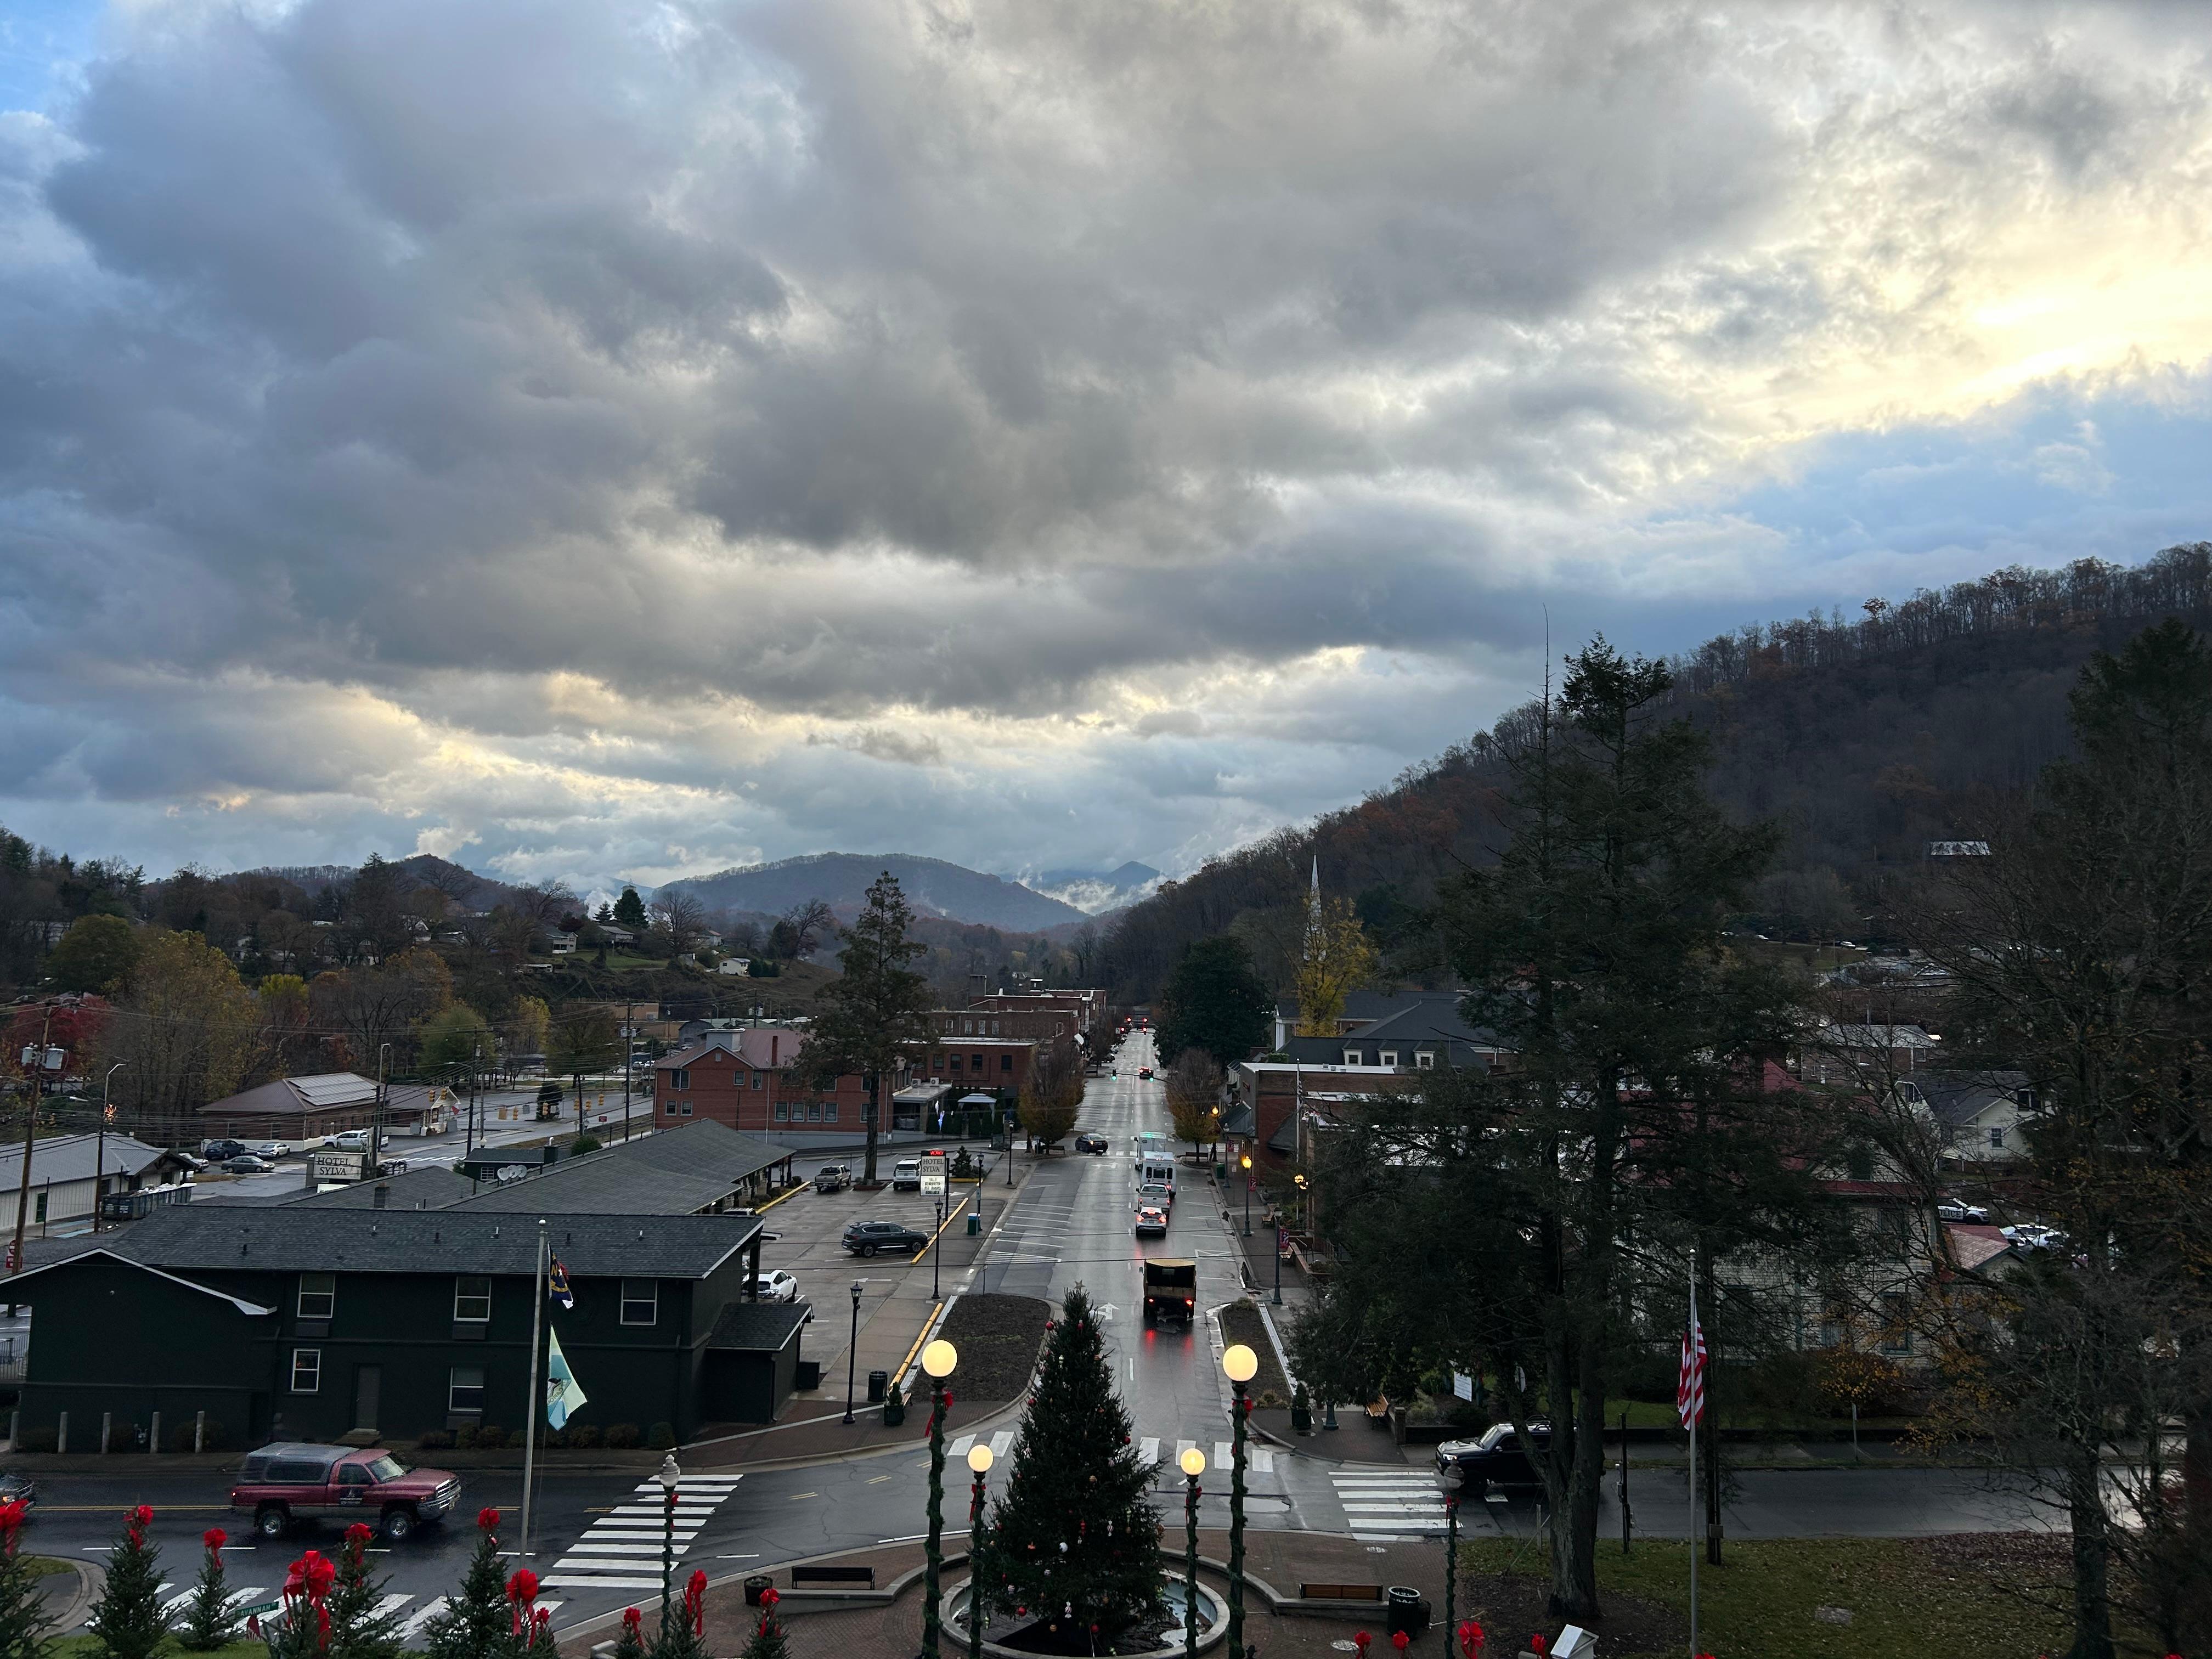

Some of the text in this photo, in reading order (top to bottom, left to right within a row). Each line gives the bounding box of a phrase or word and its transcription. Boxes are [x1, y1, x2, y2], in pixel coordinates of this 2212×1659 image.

[318, 1157, 351, 1166] HOTEL
[320, 1166, 347, 1176] SYLVA
[240, 1604, 270, 1617] AVANNAH
